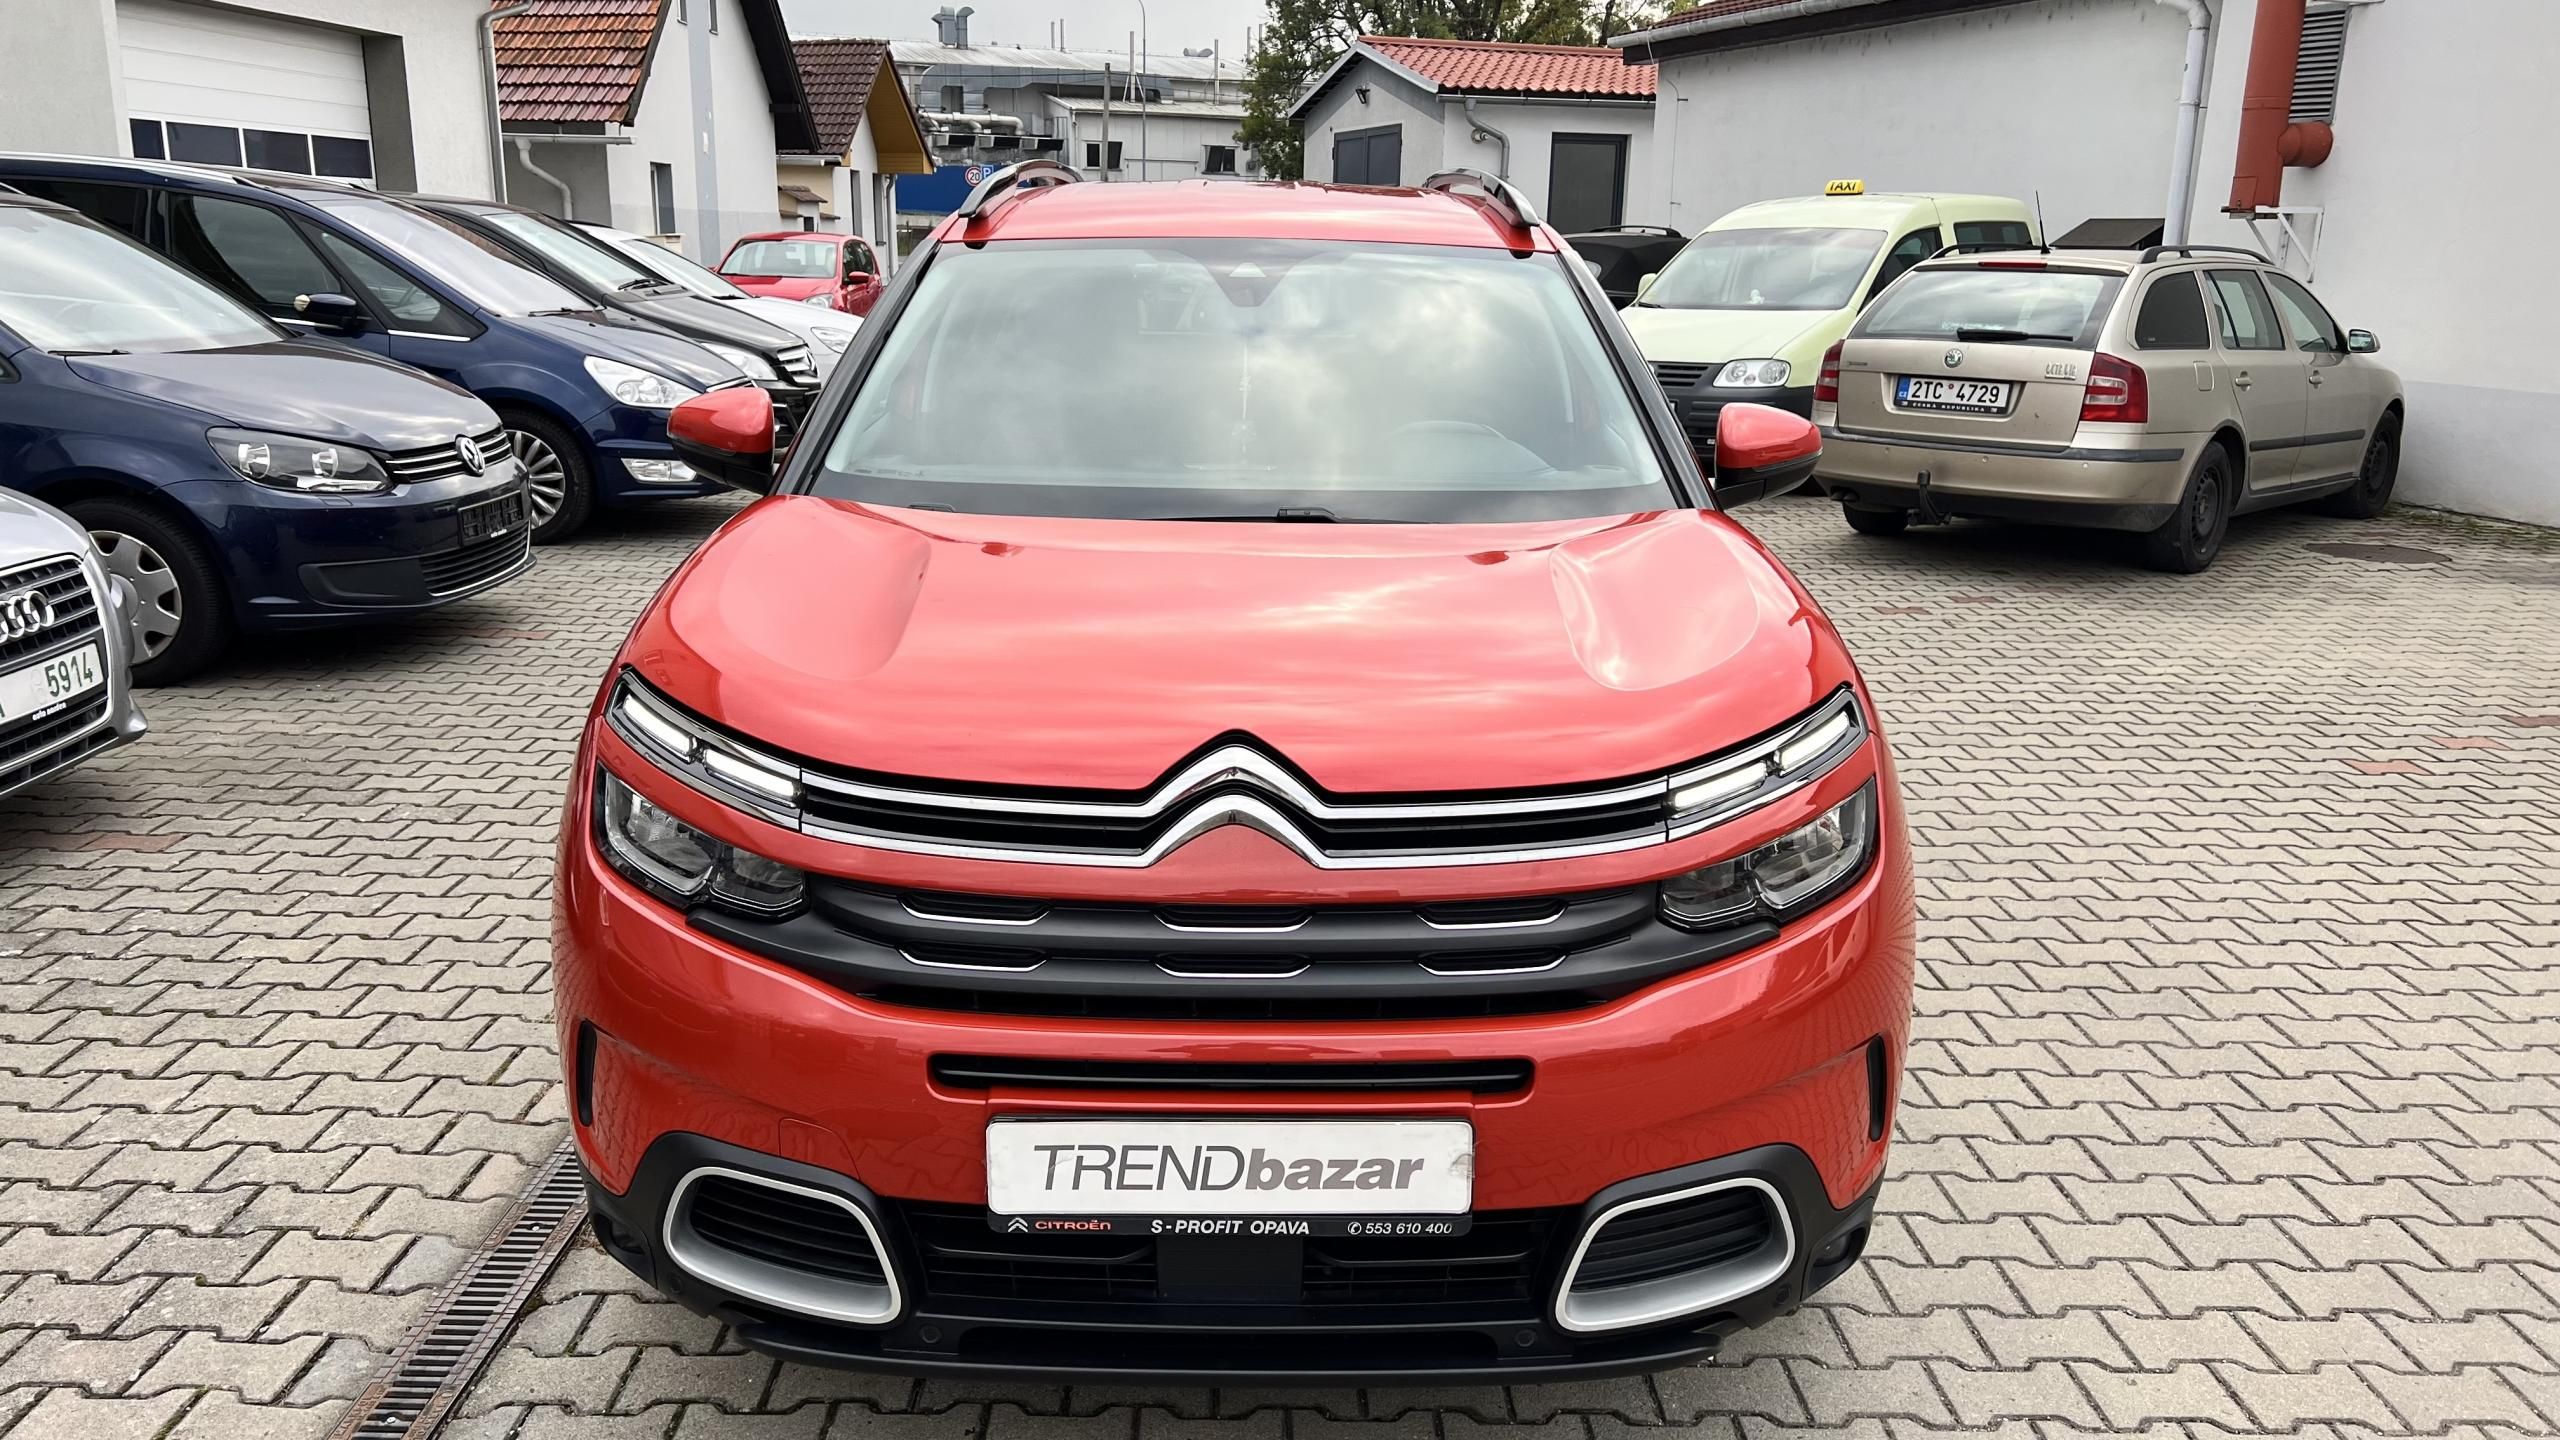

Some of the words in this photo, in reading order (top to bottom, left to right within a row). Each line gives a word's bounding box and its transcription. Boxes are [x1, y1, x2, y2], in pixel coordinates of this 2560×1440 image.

[970, 172, 980, 181] 20
[1829, 181, 1857, 191] TAXI
[1911, 380, 1944, 399] 2TC
[1955, 383, 2000, 403] 4729
[44, 651, 93, 697] 5914
[1033, 1144, 1425, 1191] TRENDbazar
[1250, 1220, 1310, 1235] OPAVA
[1365, 1222, 1391, 1234] 553
[1396, 1222, 1421, 1234] 610
[1425, 1222, 1453, 1234] 400
